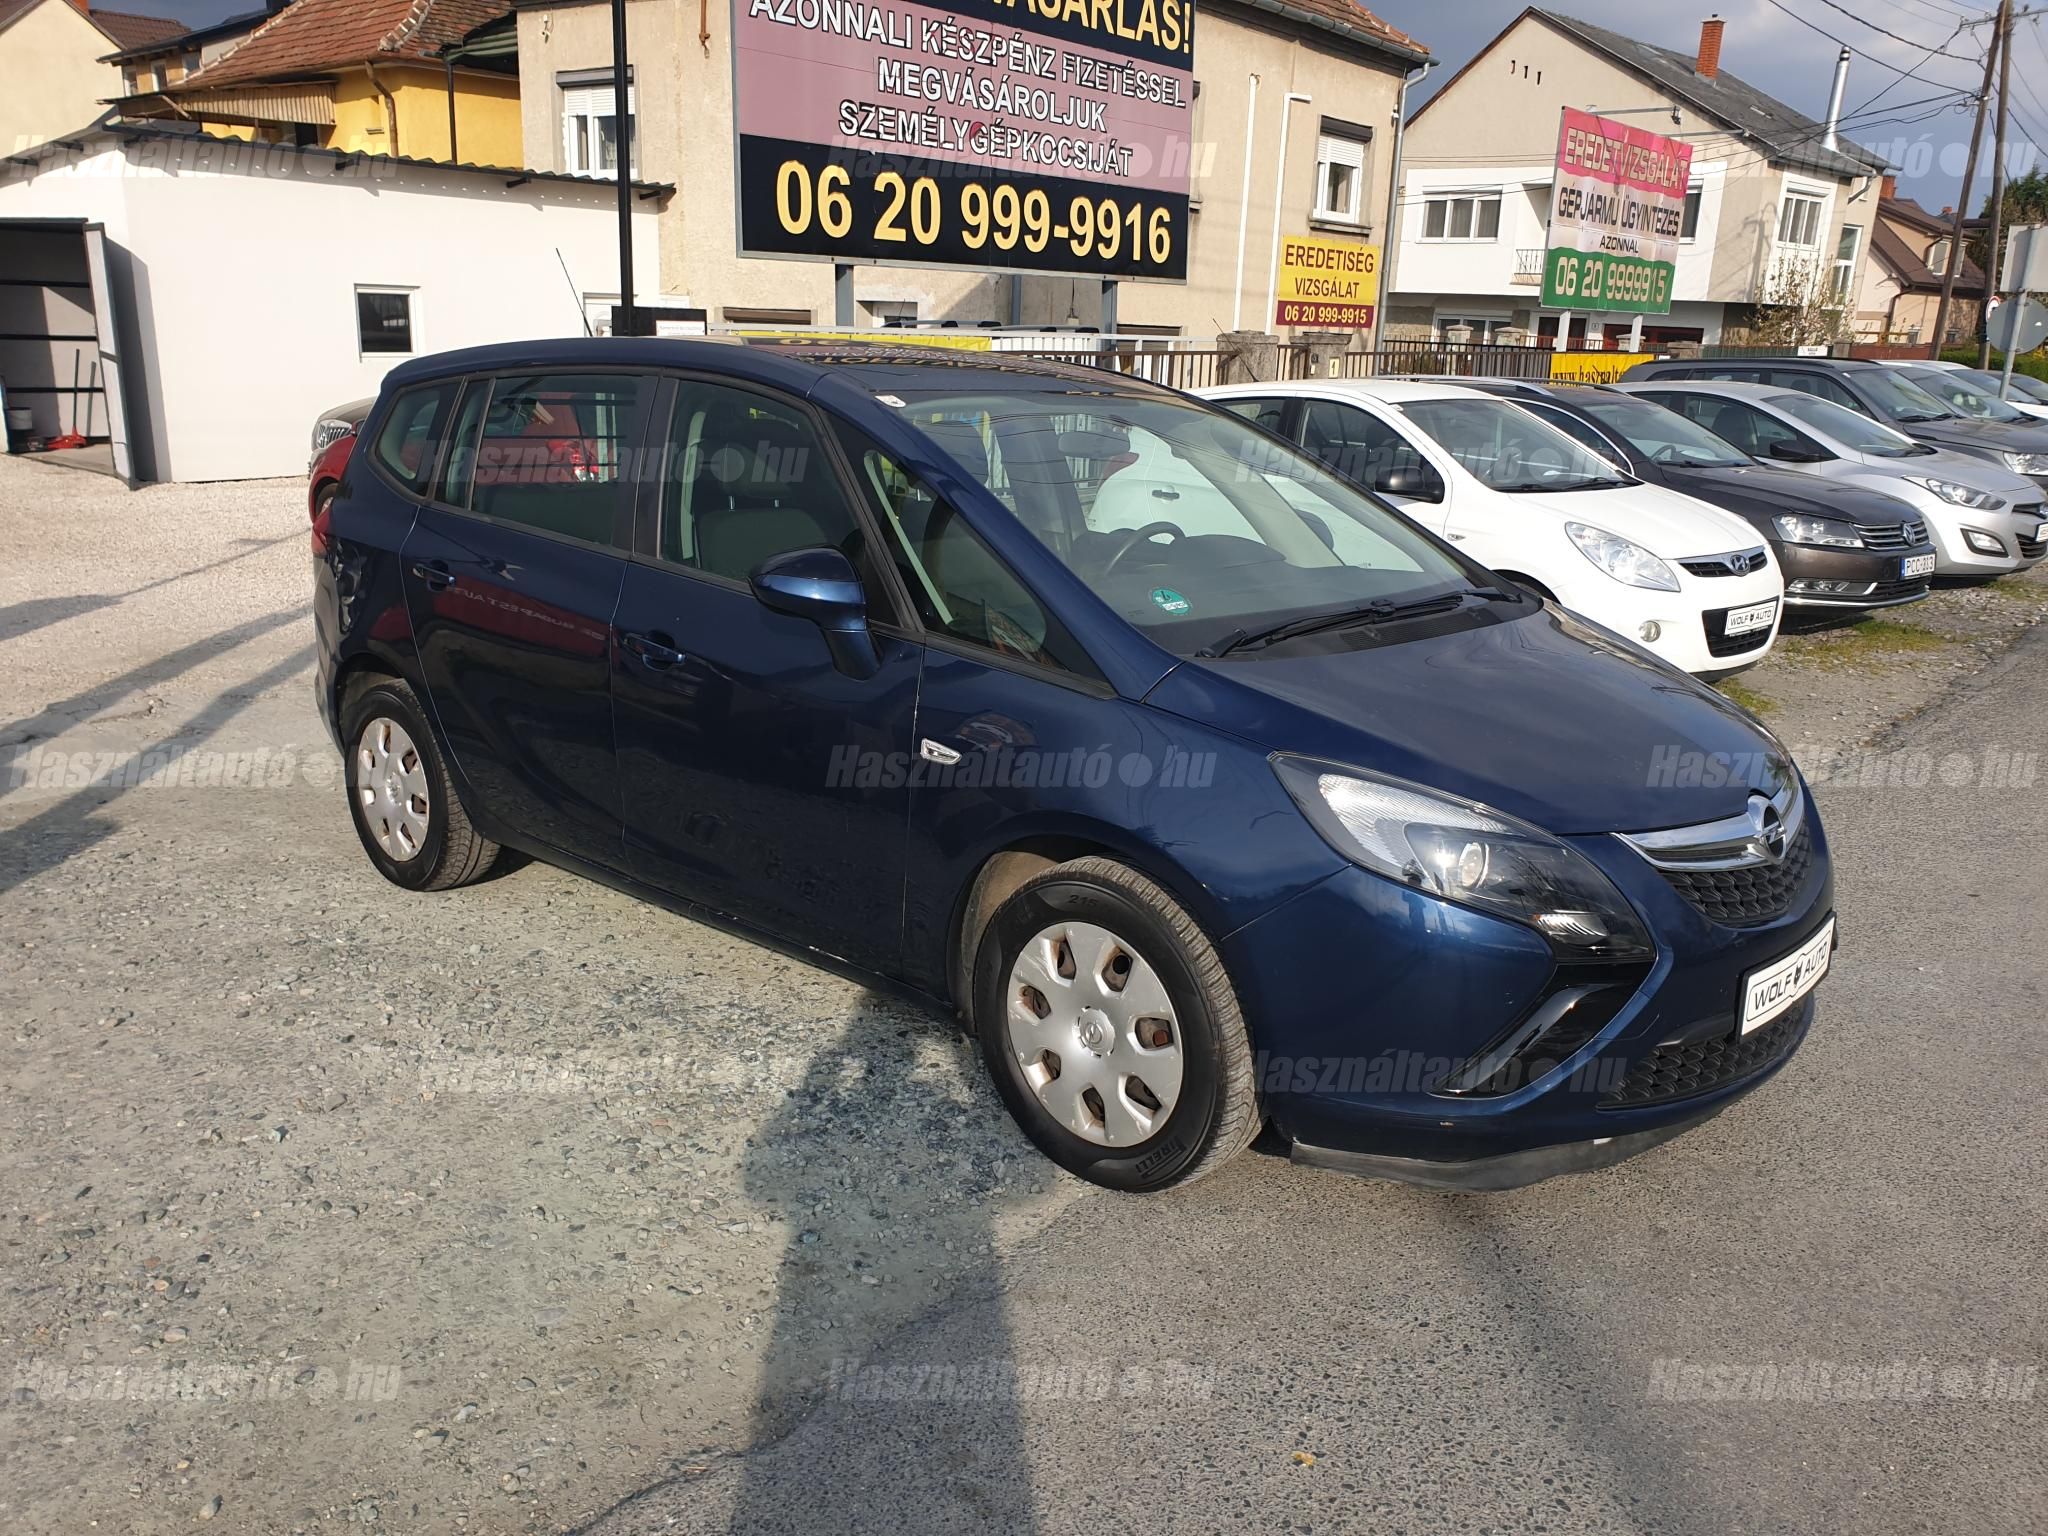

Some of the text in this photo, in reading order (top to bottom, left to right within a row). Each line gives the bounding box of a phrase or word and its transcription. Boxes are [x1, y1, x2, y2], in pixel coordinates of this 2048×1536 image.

[749, 0, 912, 49] AZONNALI
[878, 56, 1107, 132] MEGVÁSÁROLJUK
[838, 99, 1133, 177] SZEMÉLYGÉPKOCSIJÁT
[776, 160, 1171, 264] 06 20 999-9916
[1285, 244, 1374, 273] EREDETISÉG
[1600, 235, 1639, 254] AZONNAL
[1295, 276, 1360, 298] VIZSGÁLAT
[1555, 256, 1578, 297] 06
[1581, 260, 1603, 298] 20
[1285, 305, 1367, 324] 06 20 999-9915
[1731, 609, 1772, 626] WOLF AUTO
[1755, 941, 1828, 1011] WOLF AUTO
